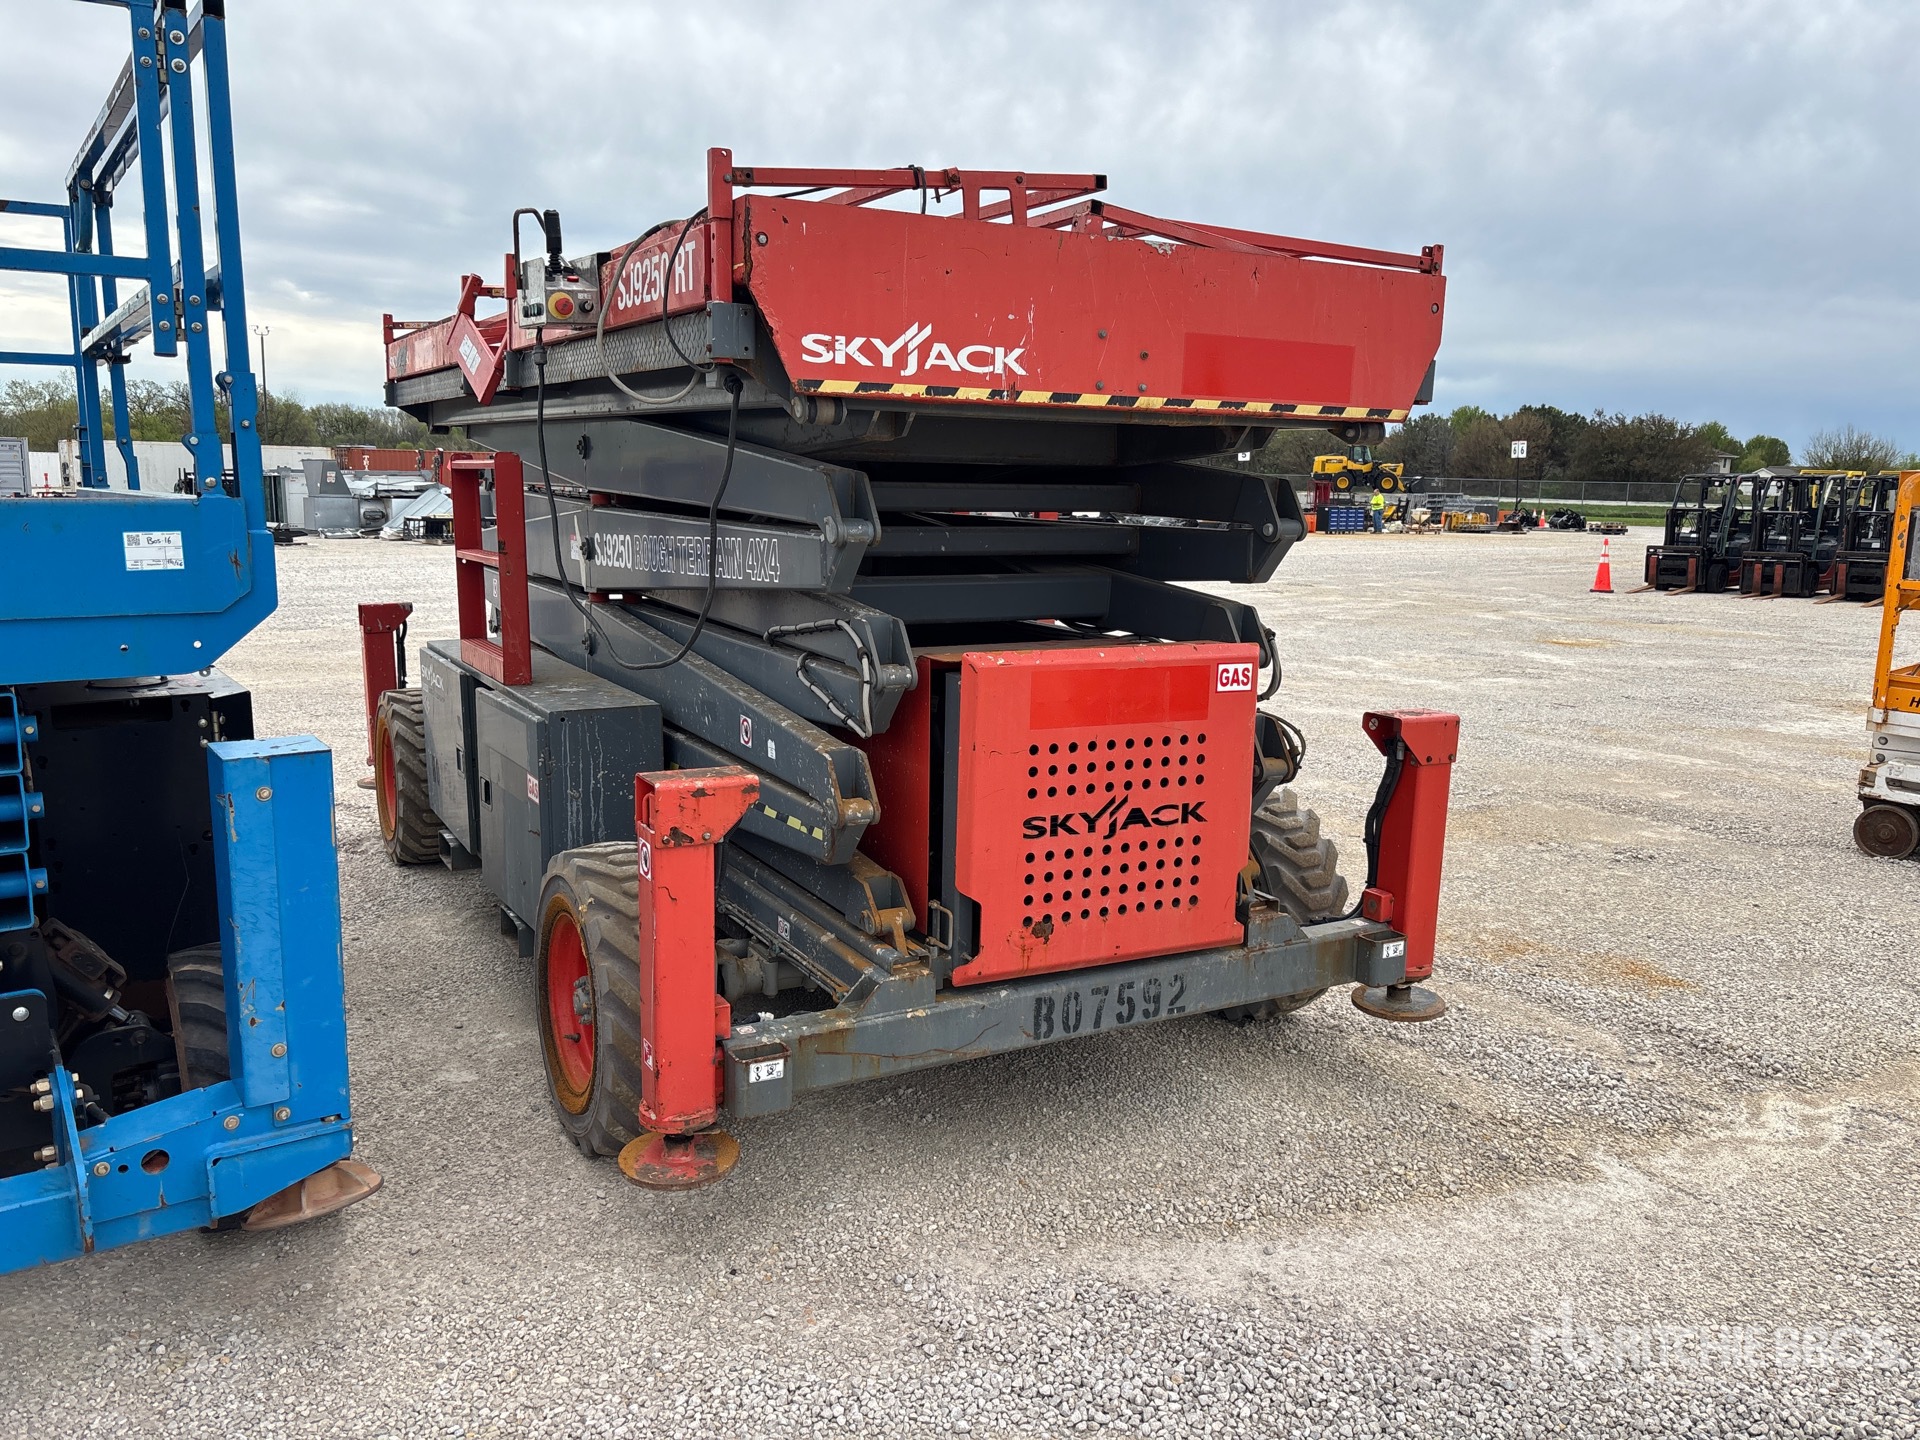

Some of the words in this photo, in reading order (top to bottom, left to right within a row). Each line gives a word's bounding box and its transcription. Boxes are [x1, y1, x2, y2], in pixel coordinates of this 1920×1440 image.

[617, 251, 669, 311] SJ9250
[674, 240, 696, 295] RT
[801, 321, 1030, 377] SKYJACK
[594, 532, 633, 569] SJ9250
[633, 534, 676, 574] ROUGH
[745, 537, 781, 583] 4X4
[1218, 667, 1251, 688] GAS
[1022, 794, 1208, 840] SKYJACK
[1033, 973, 1187, 1041] B07592
